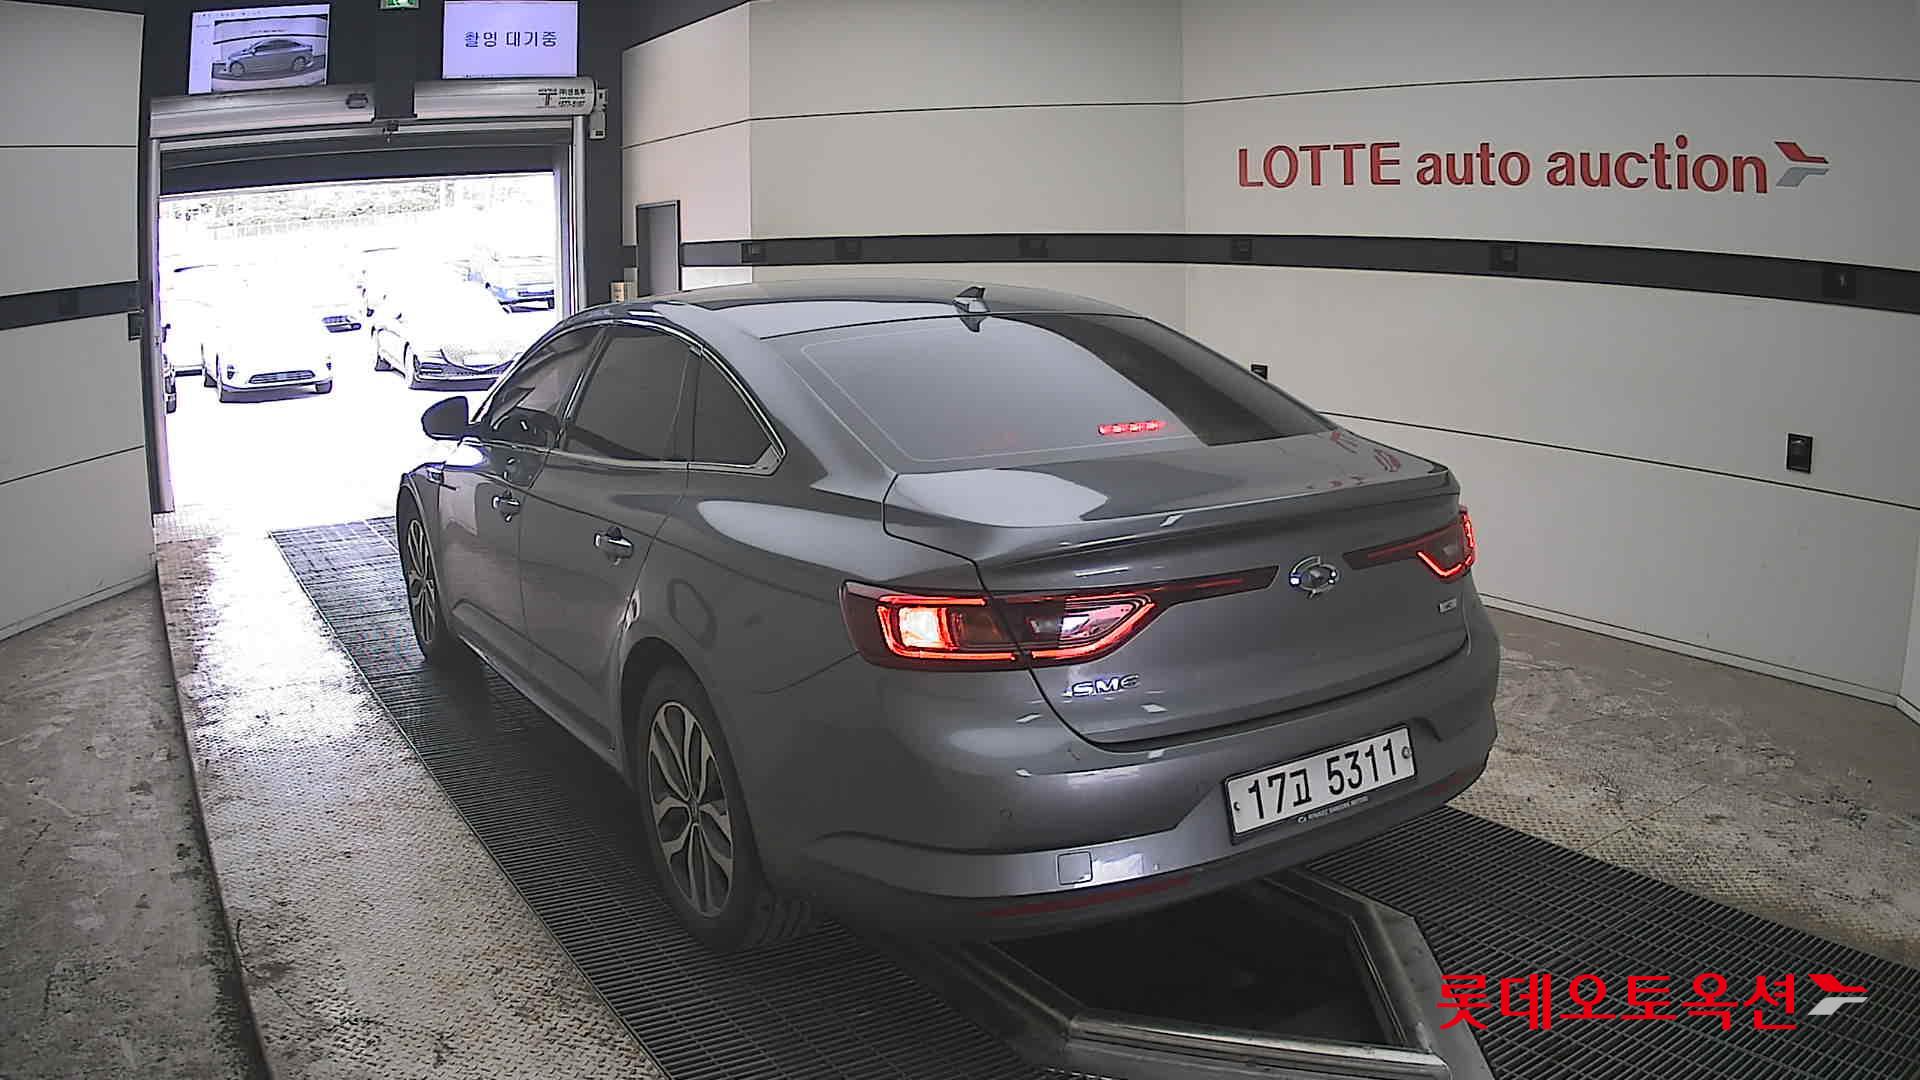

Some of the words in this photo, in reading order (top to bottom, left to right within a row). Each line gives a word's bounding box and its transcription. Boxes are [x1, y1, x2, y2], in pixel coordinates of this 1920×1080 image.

[506, 31, 558, 48] 대기중
[1238, 142, 1401, 188] LOTTE
[1416, 142, 1531, 186] auto
[1546, 135, 1768, 193] auction
[1248, 768, 1312, 820] 17고
[1326, 738, 1397, 796] 5311
